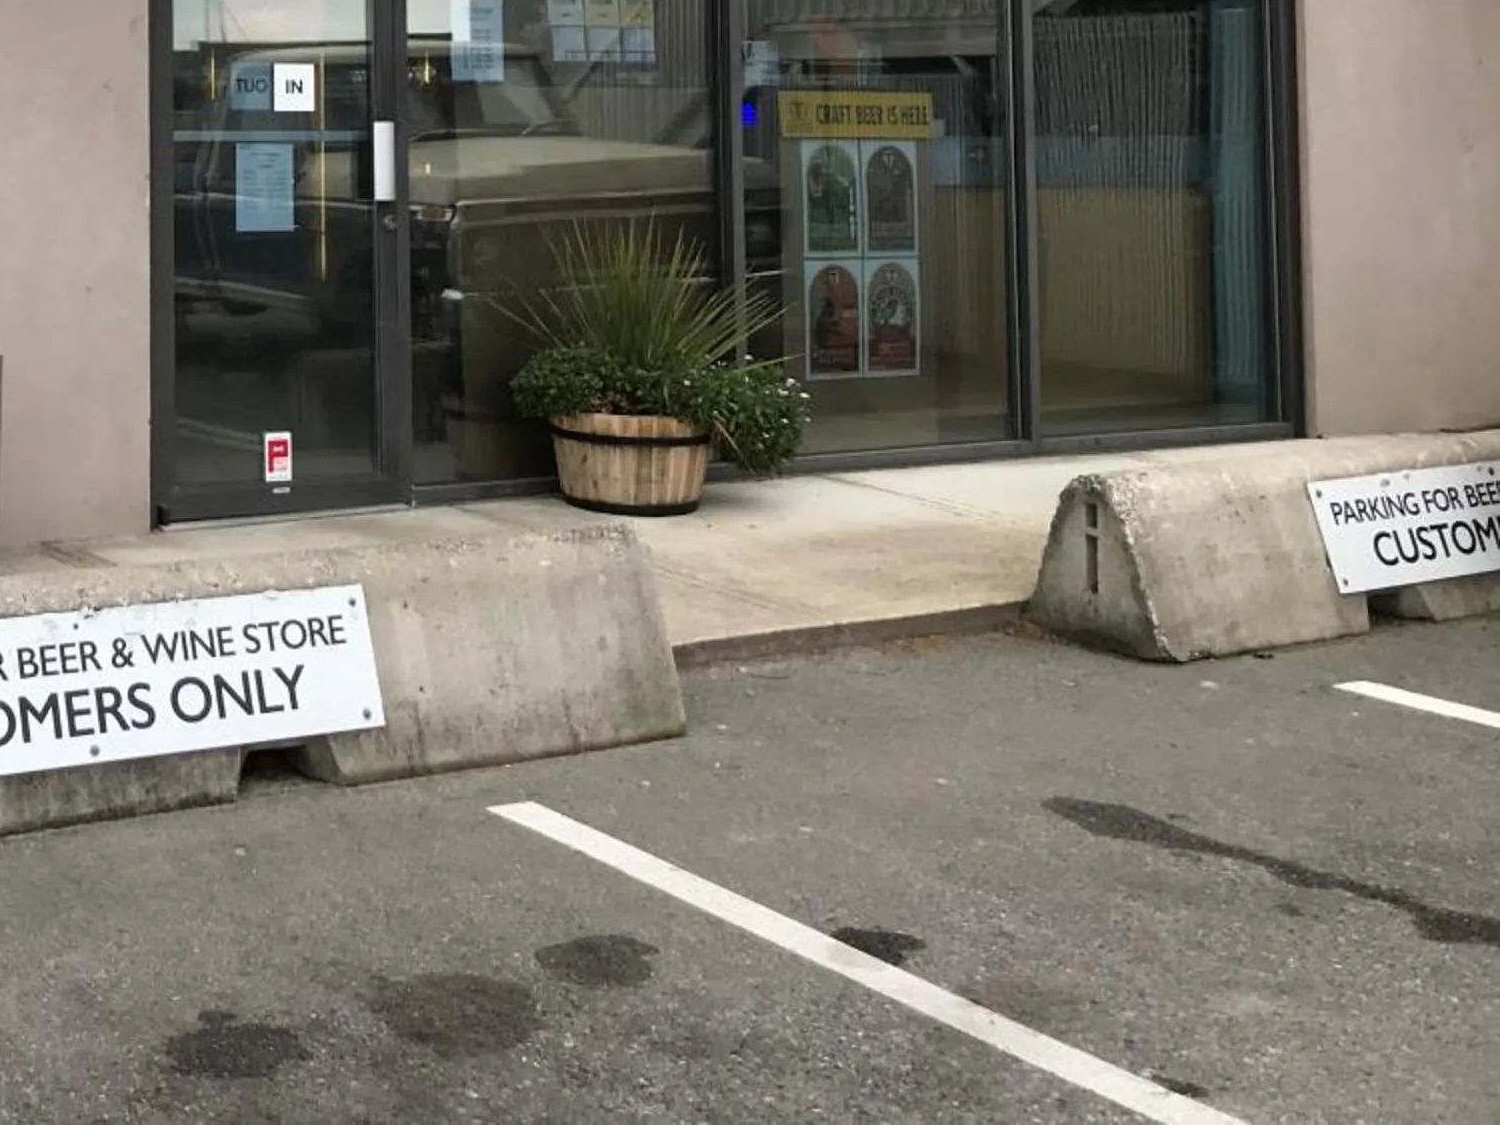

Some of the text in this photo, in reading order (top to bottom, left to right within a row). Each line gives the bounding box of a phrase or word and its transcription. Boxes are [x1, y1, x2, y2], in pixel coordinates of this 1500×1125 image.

[284, 78, 304, 94] IN
[815, 104, 929, 126] CRAFT BEER IS HERE
[1329, 480, 1500, 526] PARKING FOR BEE
[1373, 515, 1500, 567] CUSTOM
[17, 640, 103, 679] BEER
[111, 637, 136, 669] &
[141, 625, 237, 665] WINE
[243, 614, 348, 655] STORE
[170, 663, 305, 724] ONLY
